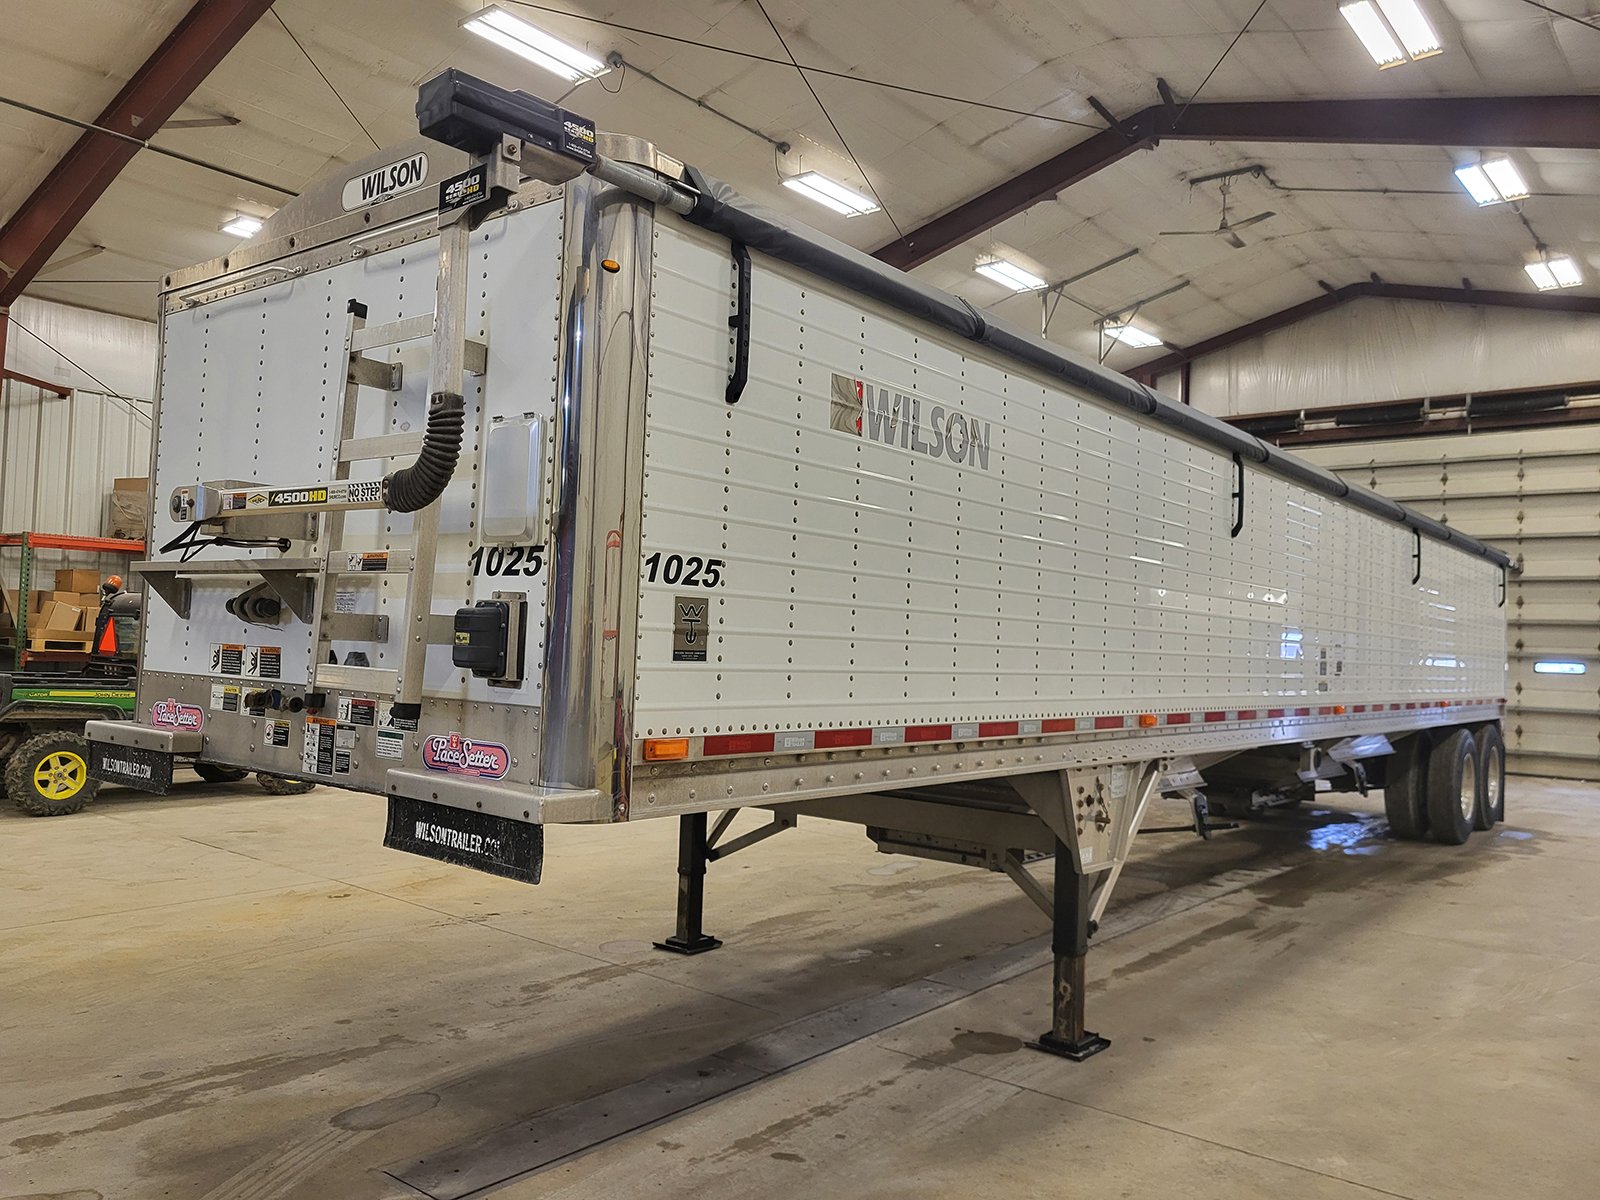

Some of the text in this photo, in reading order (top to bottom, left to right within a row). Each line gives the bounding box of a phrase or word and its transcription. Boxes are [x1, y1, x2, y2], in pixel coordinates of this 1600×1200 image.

[361, 156, 423, 201] WILSON
[445, 174, 480, 194] 4500
[866, 383, 991, 471] WILSON
[274, 489, 327, 504] 4500HD
[348, 486, 380, 498] NO STEP
[471, 545, 546, 577] 1025
[644, 552, 722, 588] 1025
[102, 757, 152, 779] WILSONTRAILER.COM
